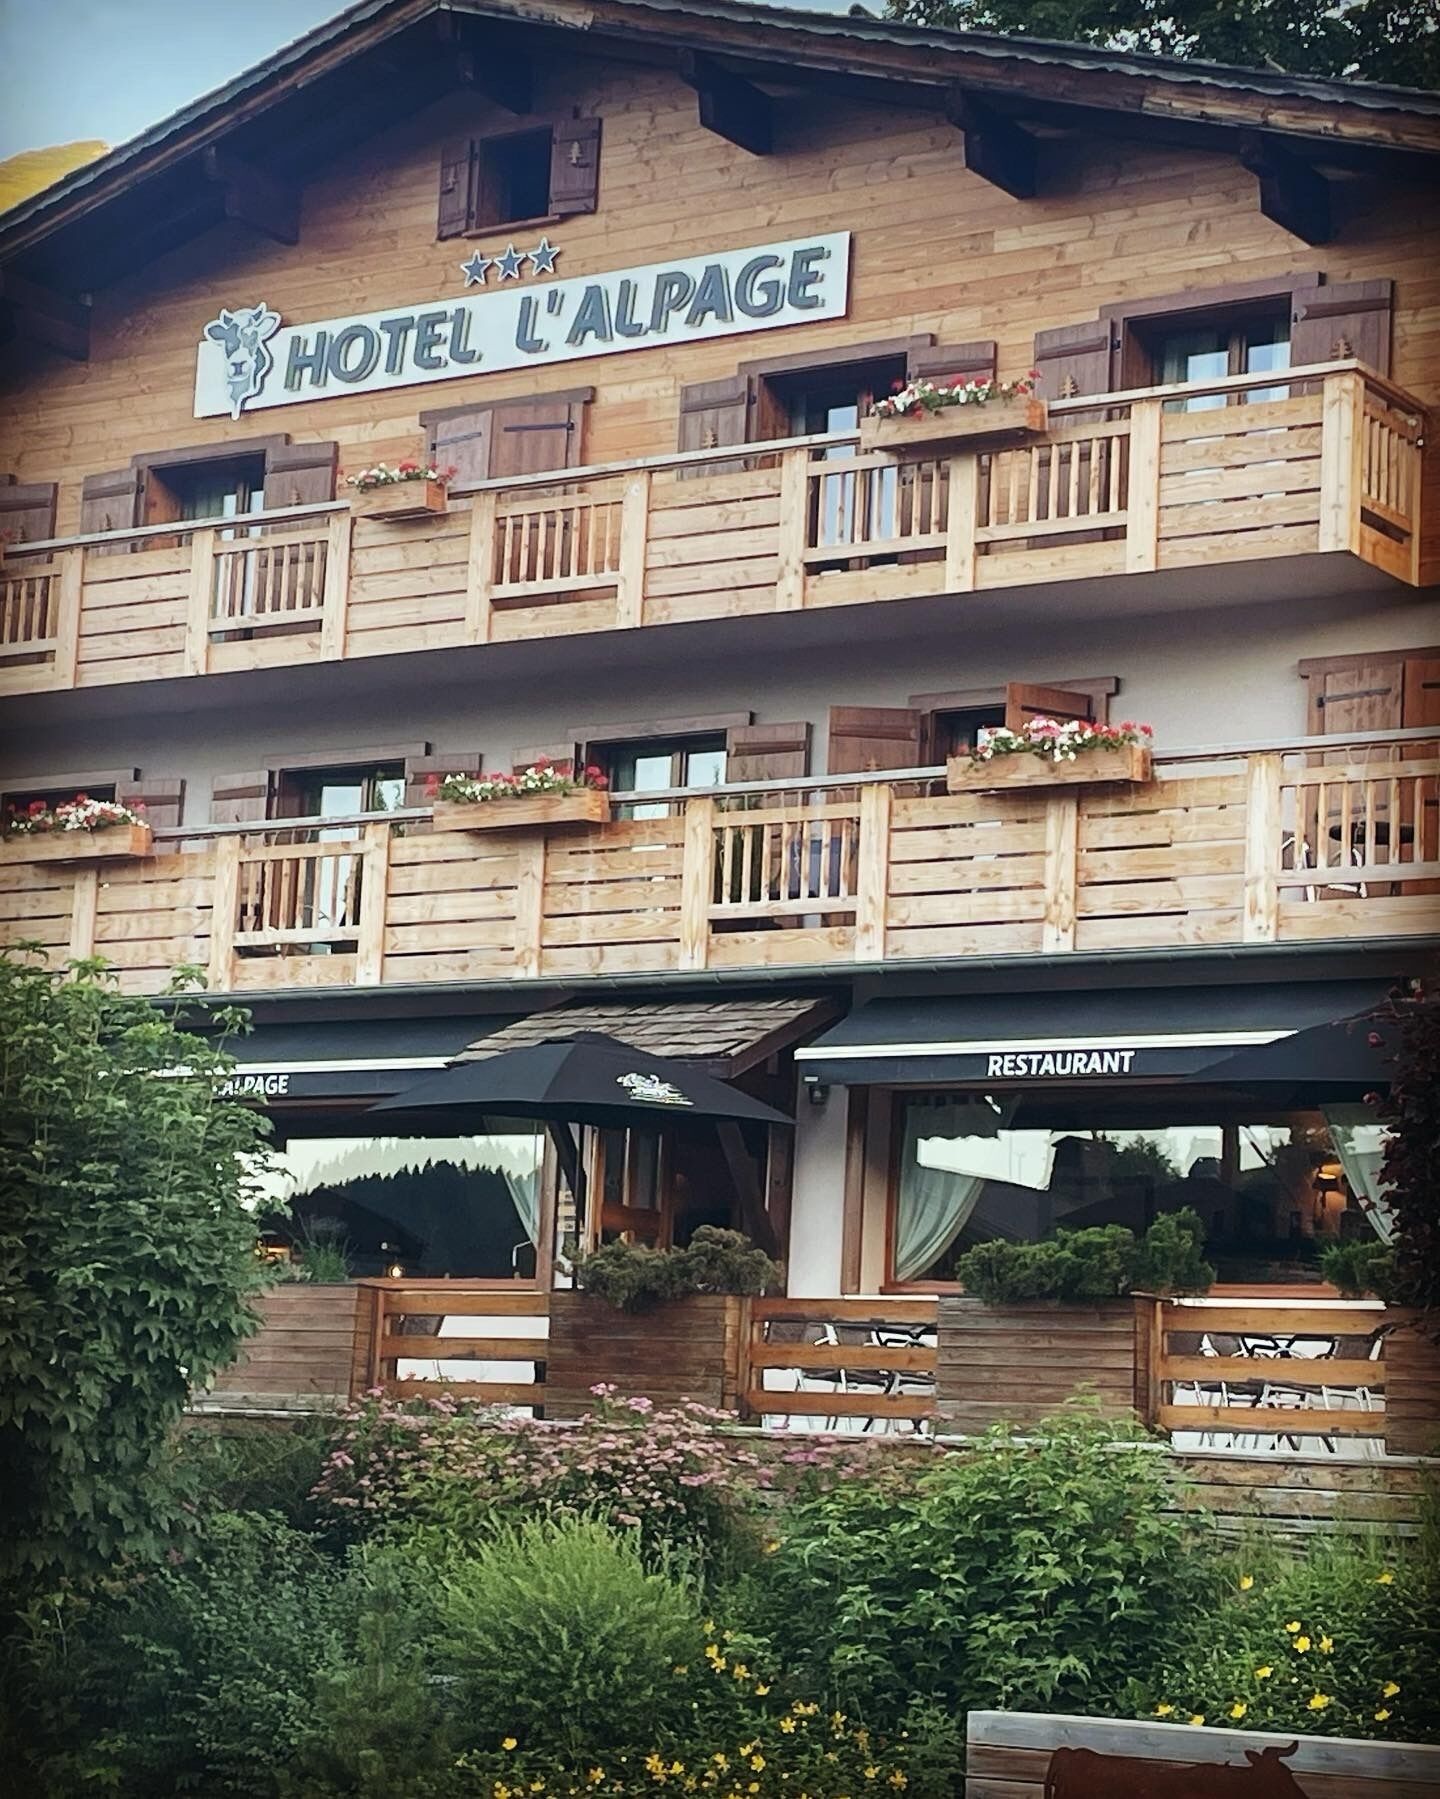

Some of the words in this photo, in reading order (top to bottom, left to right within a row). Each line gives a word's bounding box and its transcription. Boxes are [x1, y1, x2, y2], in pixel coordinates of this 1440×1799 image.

[284, 307, 483, 392] HOTEL
[515, 246, 831, 354] L'ALPAGE
[987, 1051, 1136, 1077] RESTAURANT
